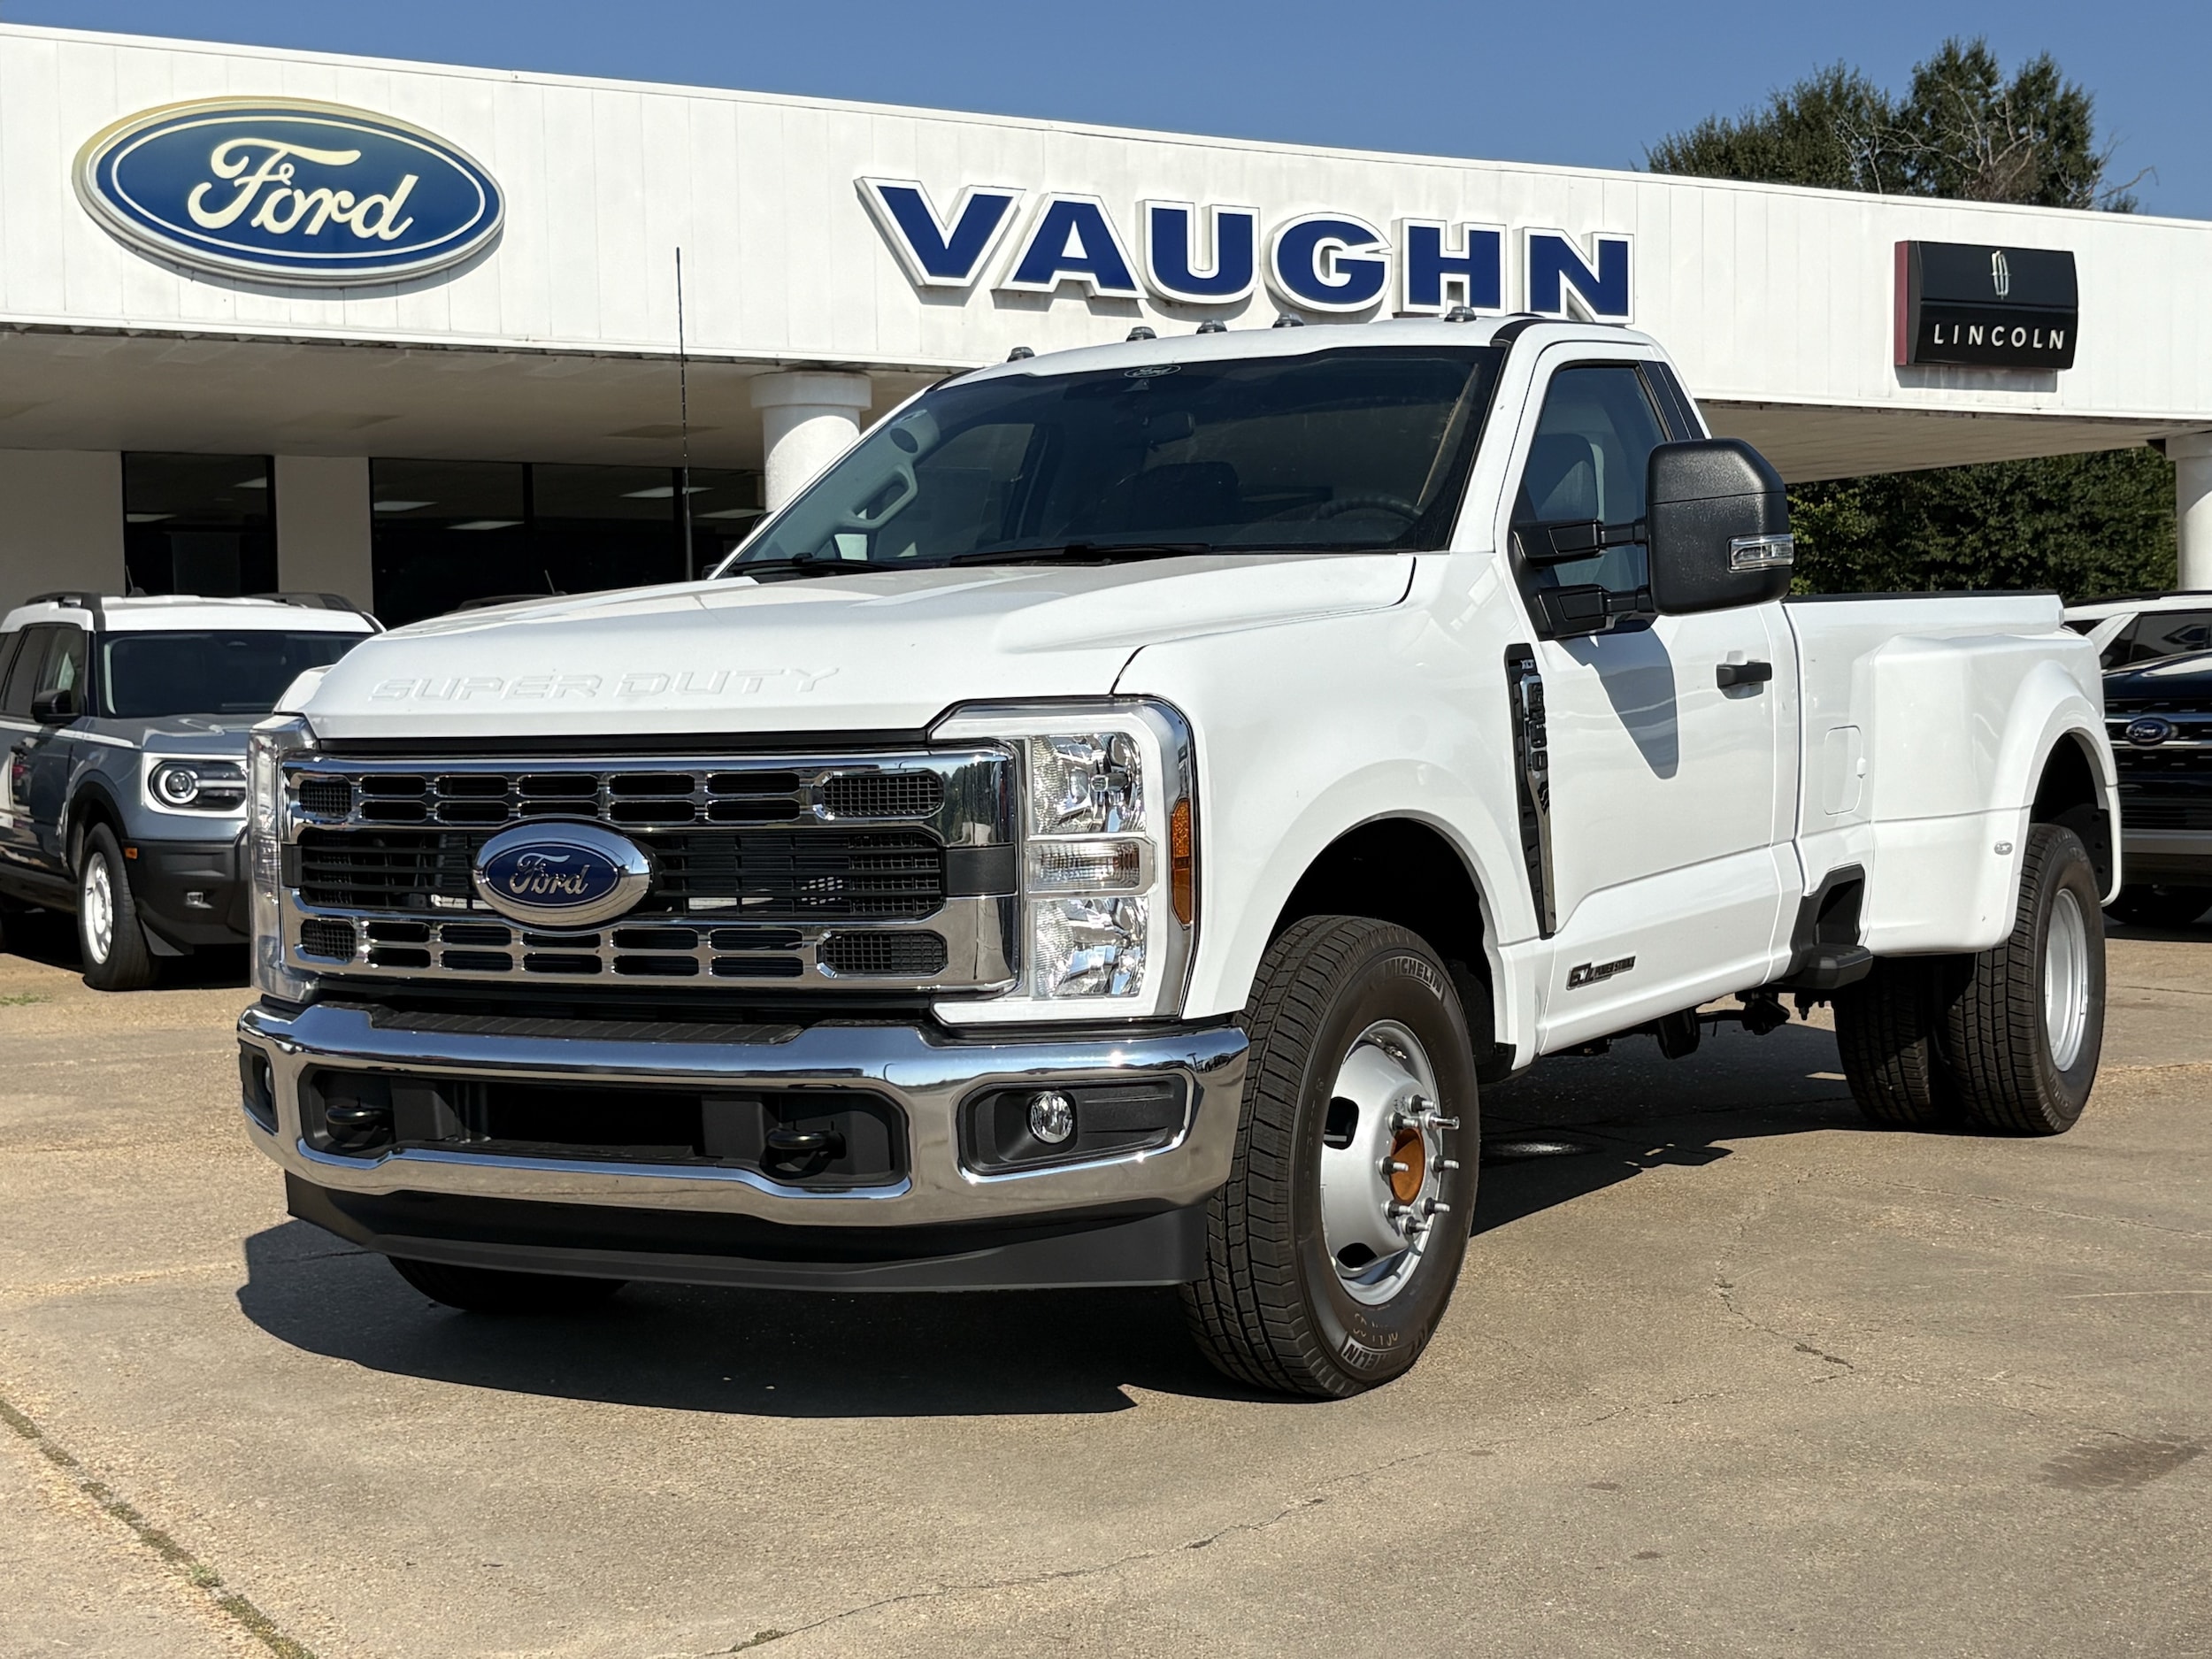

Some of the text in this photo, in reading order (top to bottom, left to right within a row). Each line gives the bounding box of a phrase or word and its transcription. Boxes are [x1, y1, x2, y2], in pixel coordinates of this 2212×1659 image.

[187, 136, 418, 242] Ford
[865, 179, 1634, 325] VAUGHN
[1933, 323, 2065, 350] LINCOLN
[369, 666, 840, 702] SUPER DUTY
[509, 852, 591, 895] Ford
[1384, 957, 1443, 995] MICHELIN
